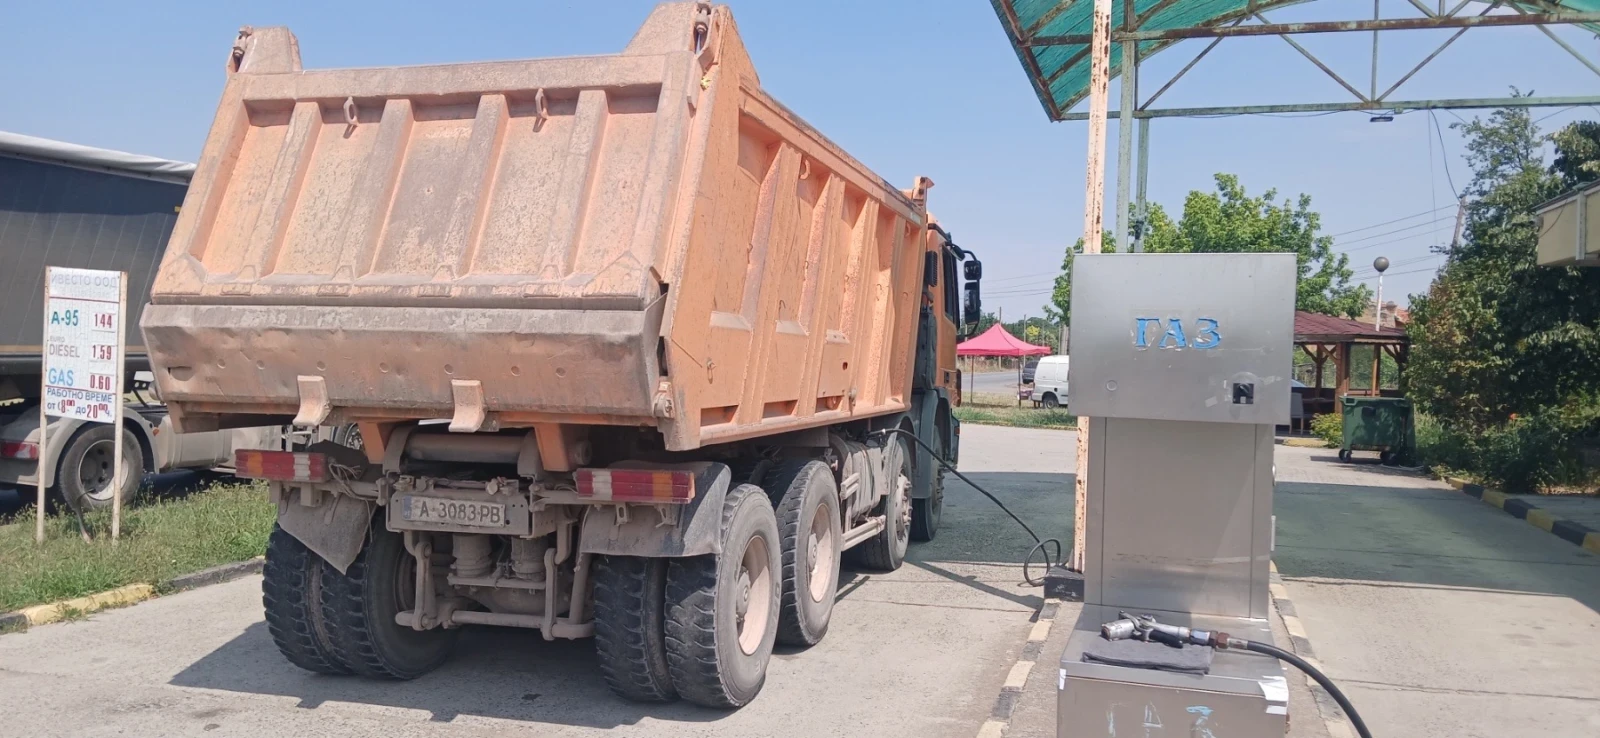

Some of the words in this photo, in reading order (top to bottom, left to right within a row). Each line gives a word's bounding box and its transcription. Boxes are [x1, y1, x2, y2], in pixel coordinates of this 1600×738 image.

[1134, 317, 1223, 350] ГАЗ
[49, 344, 80, 358] DIESEL
[92, 344, 112, 360] 1.59
[48, 367, 74, 387] GAS
[90, 374, 110, 391] 0.60
[47, 387, 83, 400] РАБОТНО
[85, 391, 112, 403] ВРЕМЕ
